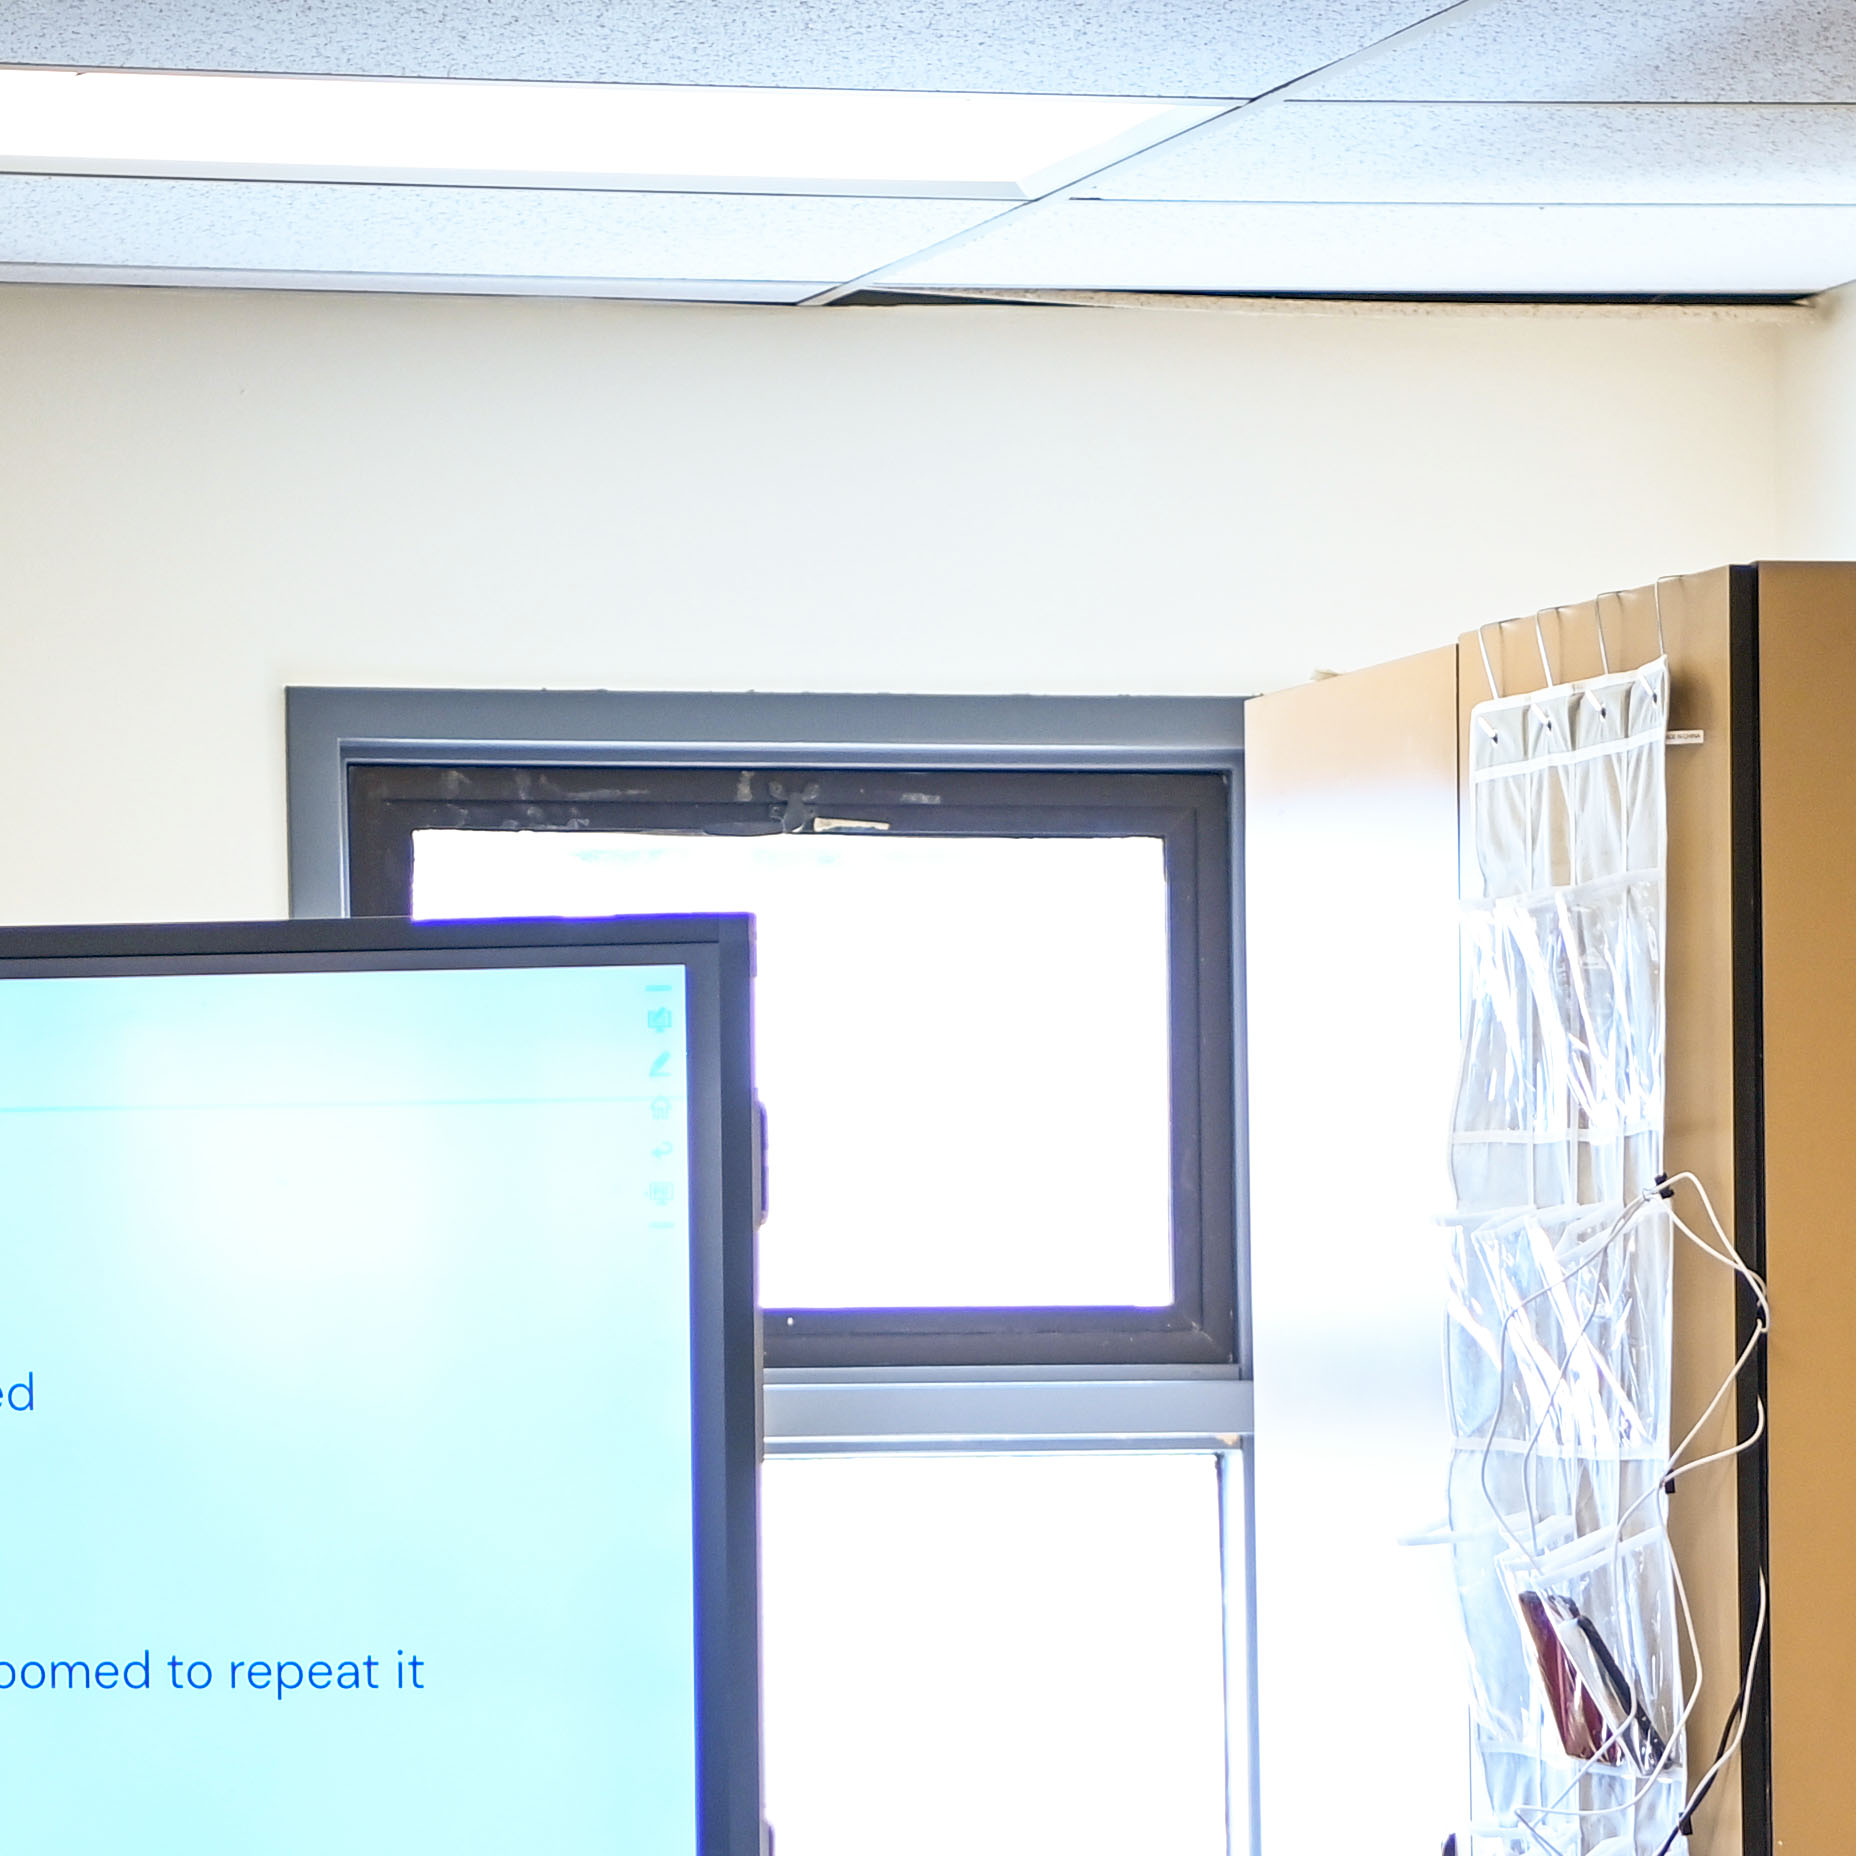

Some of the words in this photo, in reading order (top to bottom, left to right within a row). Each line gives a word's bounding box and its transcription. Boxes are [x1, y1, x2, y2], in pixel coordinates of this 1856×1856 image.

[166, 1654, 213, 1690] to
[230, 1654, 380, 1701] repeat
[397, 1649, 425, 1689] it
